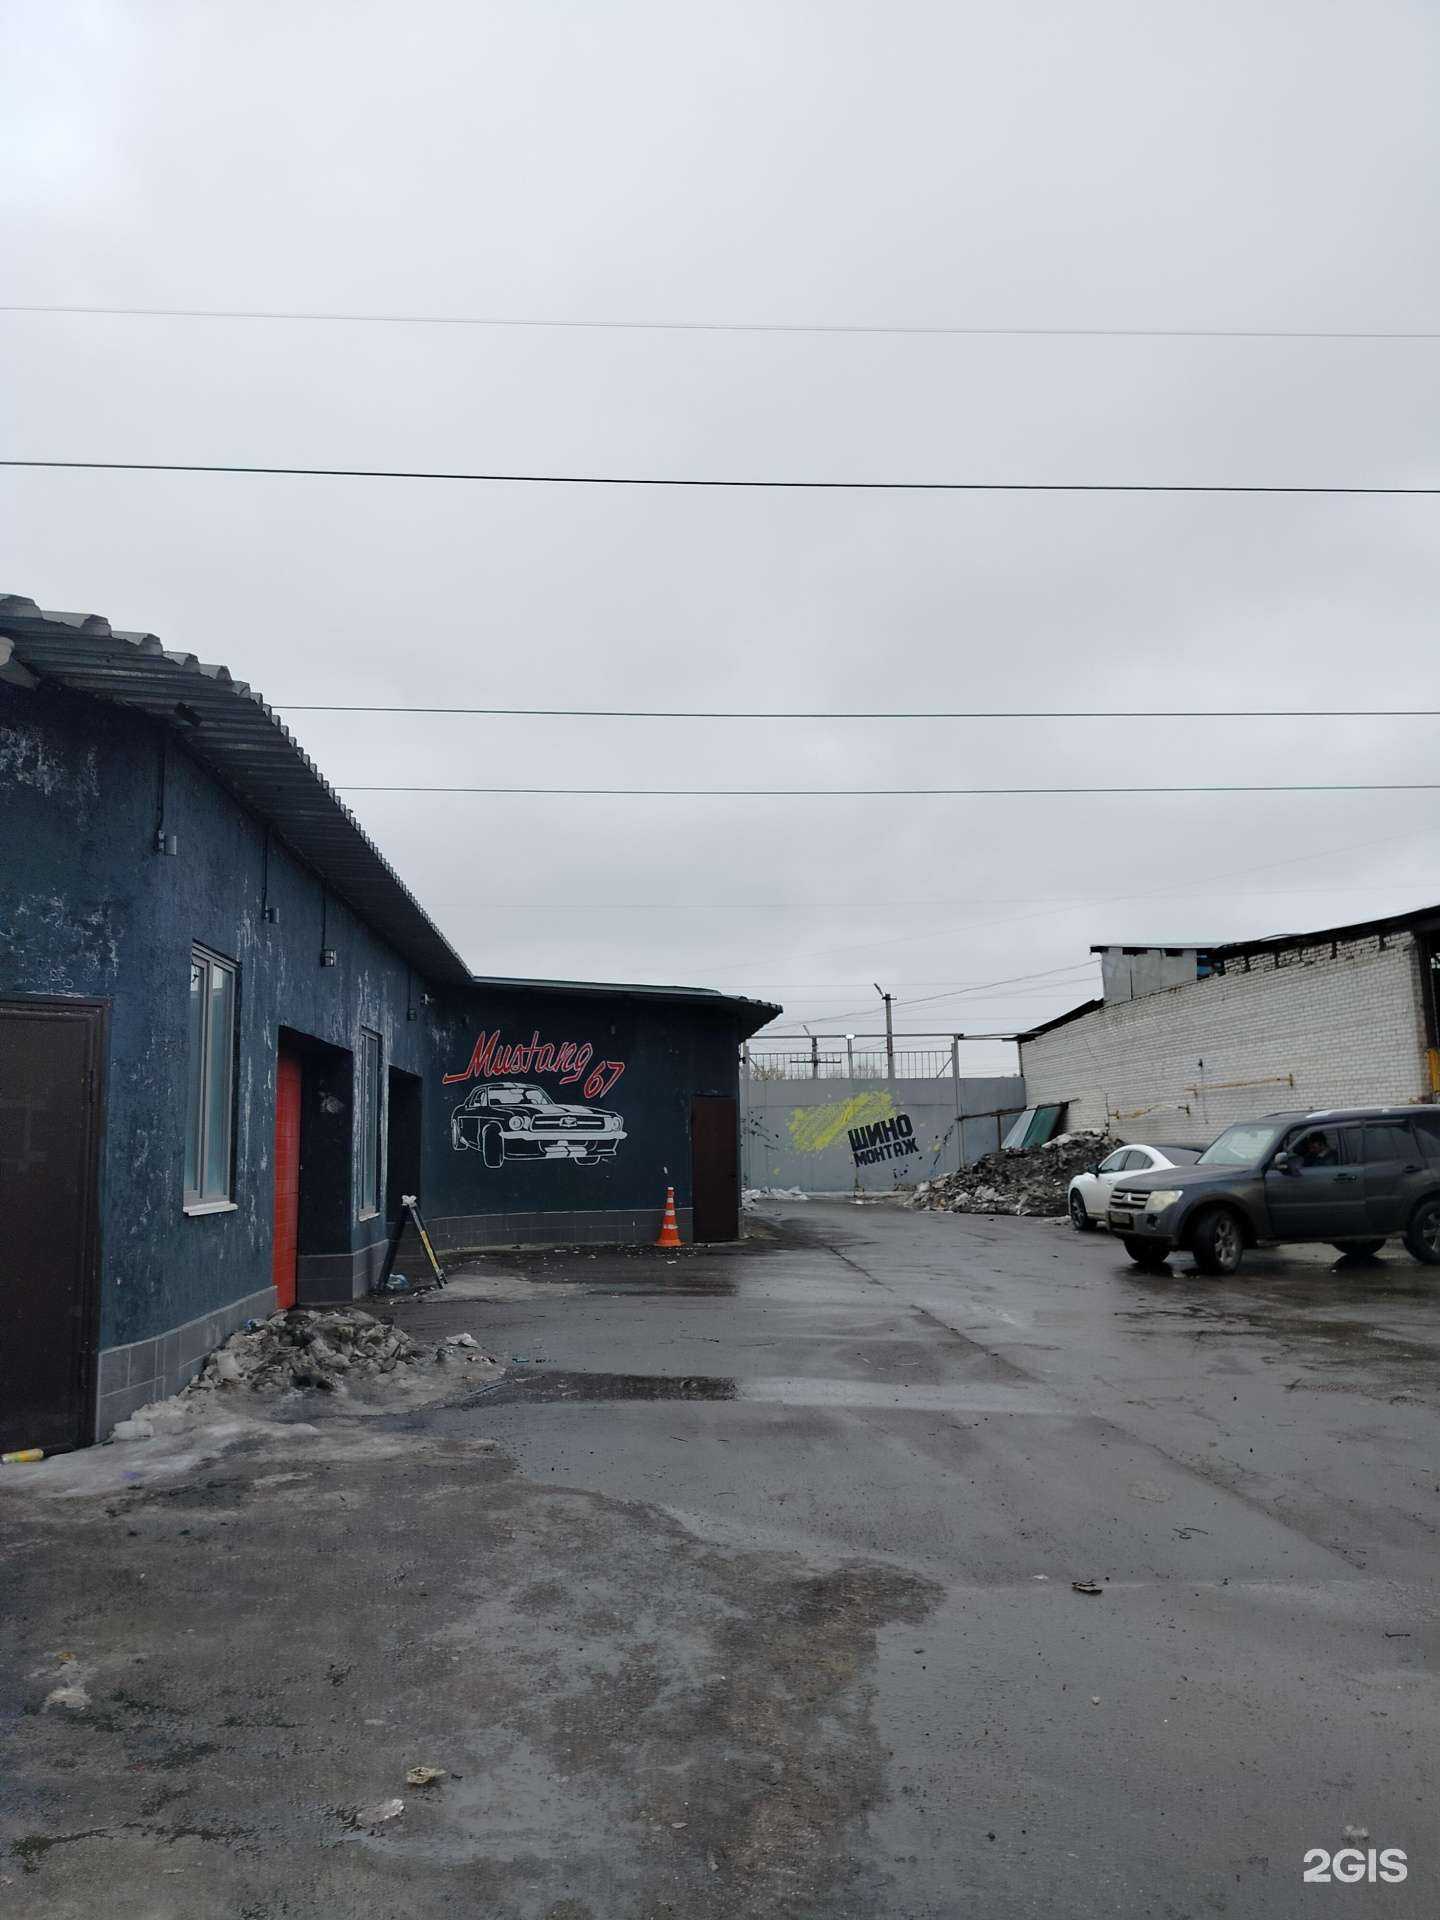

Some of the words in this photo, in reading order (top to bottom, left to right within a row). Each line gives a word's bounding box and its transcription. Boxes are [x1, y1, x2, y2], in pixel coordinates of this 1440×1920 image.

[442, 1029, 593, 1085] Mustang
[583, 1060, 625, 1099] 67
[847, 1114, 913, 1152] ШИНО
[853, 1137, 920, 1168] МОНТАЖ
